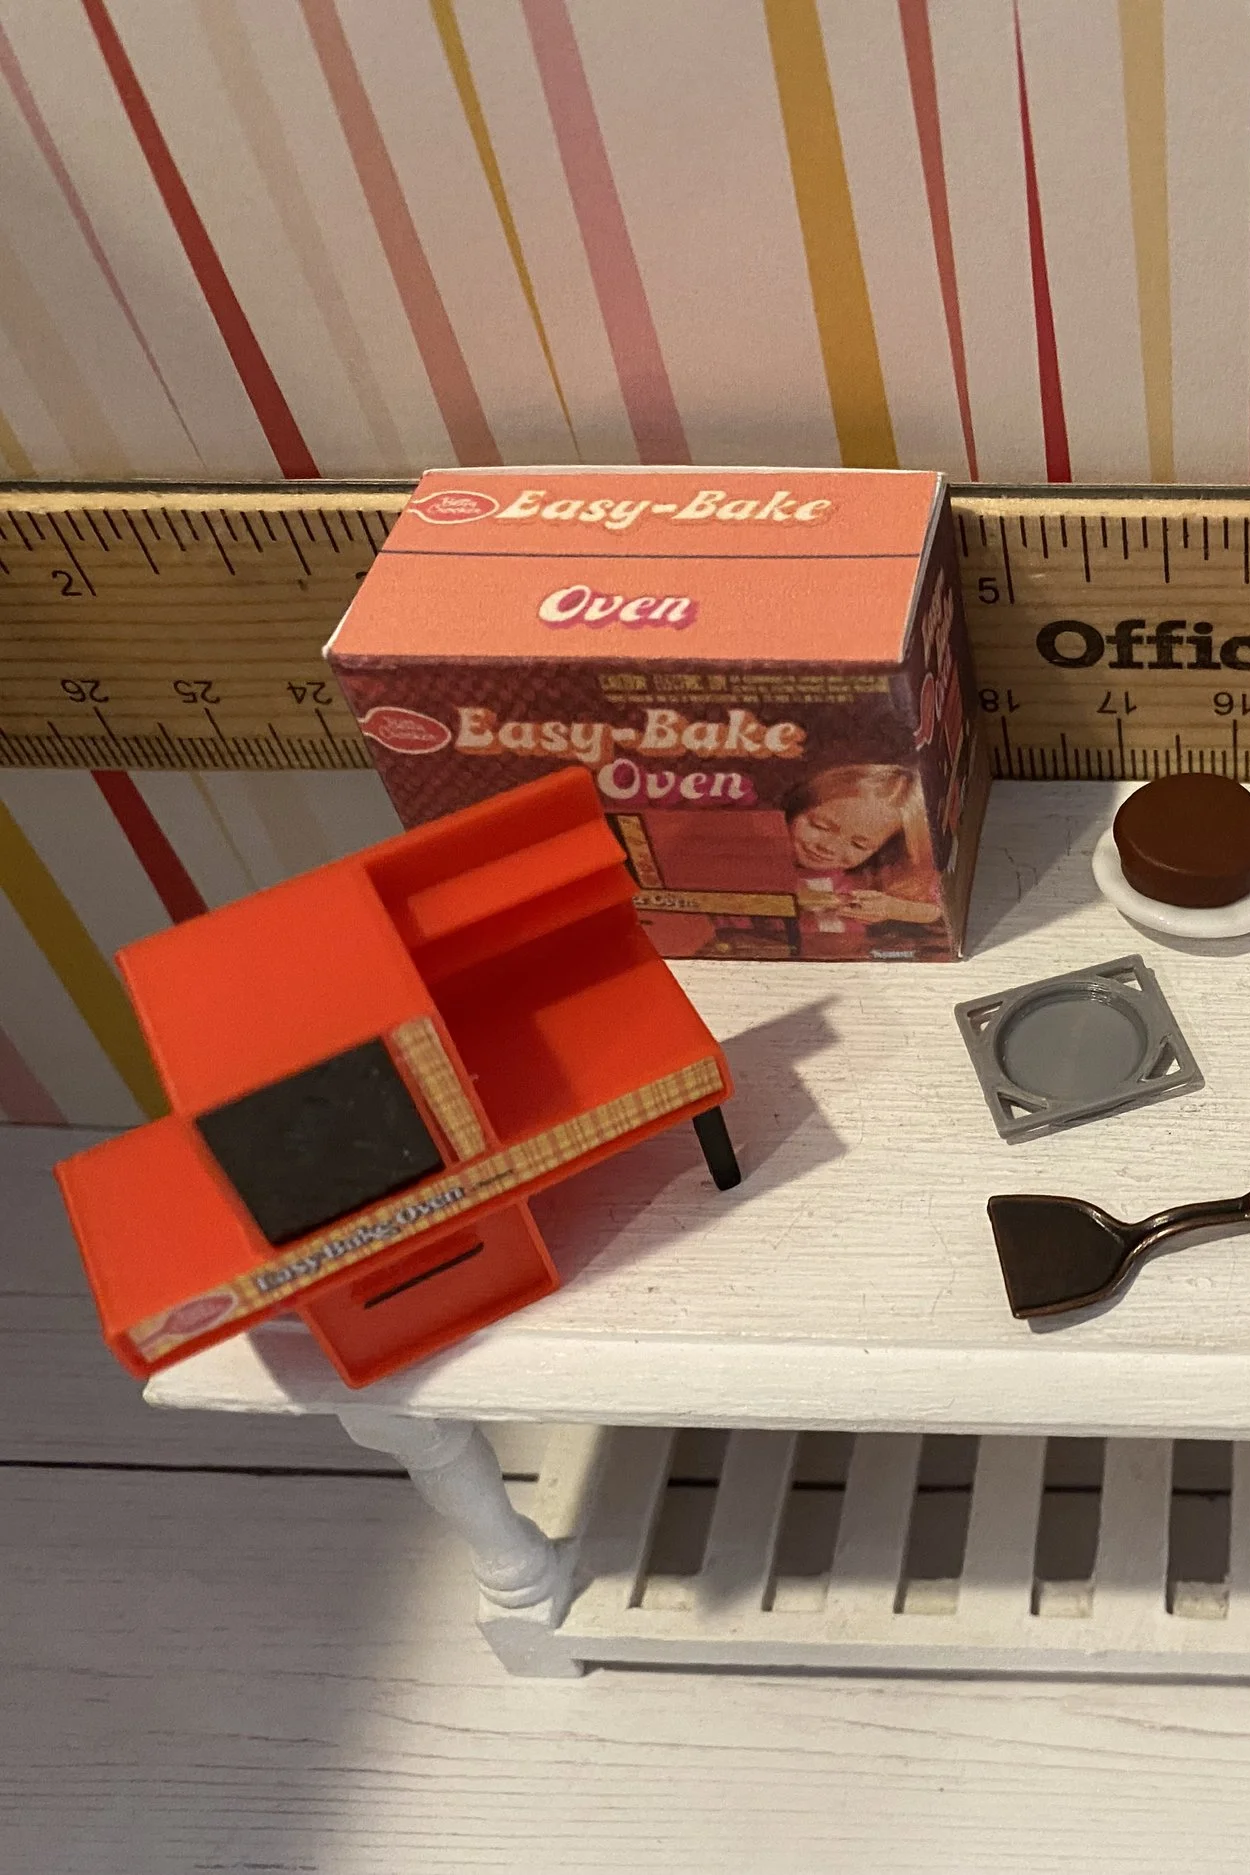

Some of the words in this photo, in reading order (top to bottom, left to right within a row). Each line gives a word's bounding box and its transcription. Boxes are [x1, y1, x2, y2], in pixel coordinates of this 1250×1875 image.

[495, 489, 833, 532] Easy-Bake
[51, 569, 82, 597] 2
[977, 577, 1000, 604] 5
[538, 584, 692, 624] Oven
[453, 705, 803, 764] Easy-Bake
[597, 757, 752, 800] Oven
[395, 1186, 466, 1226] Oven
